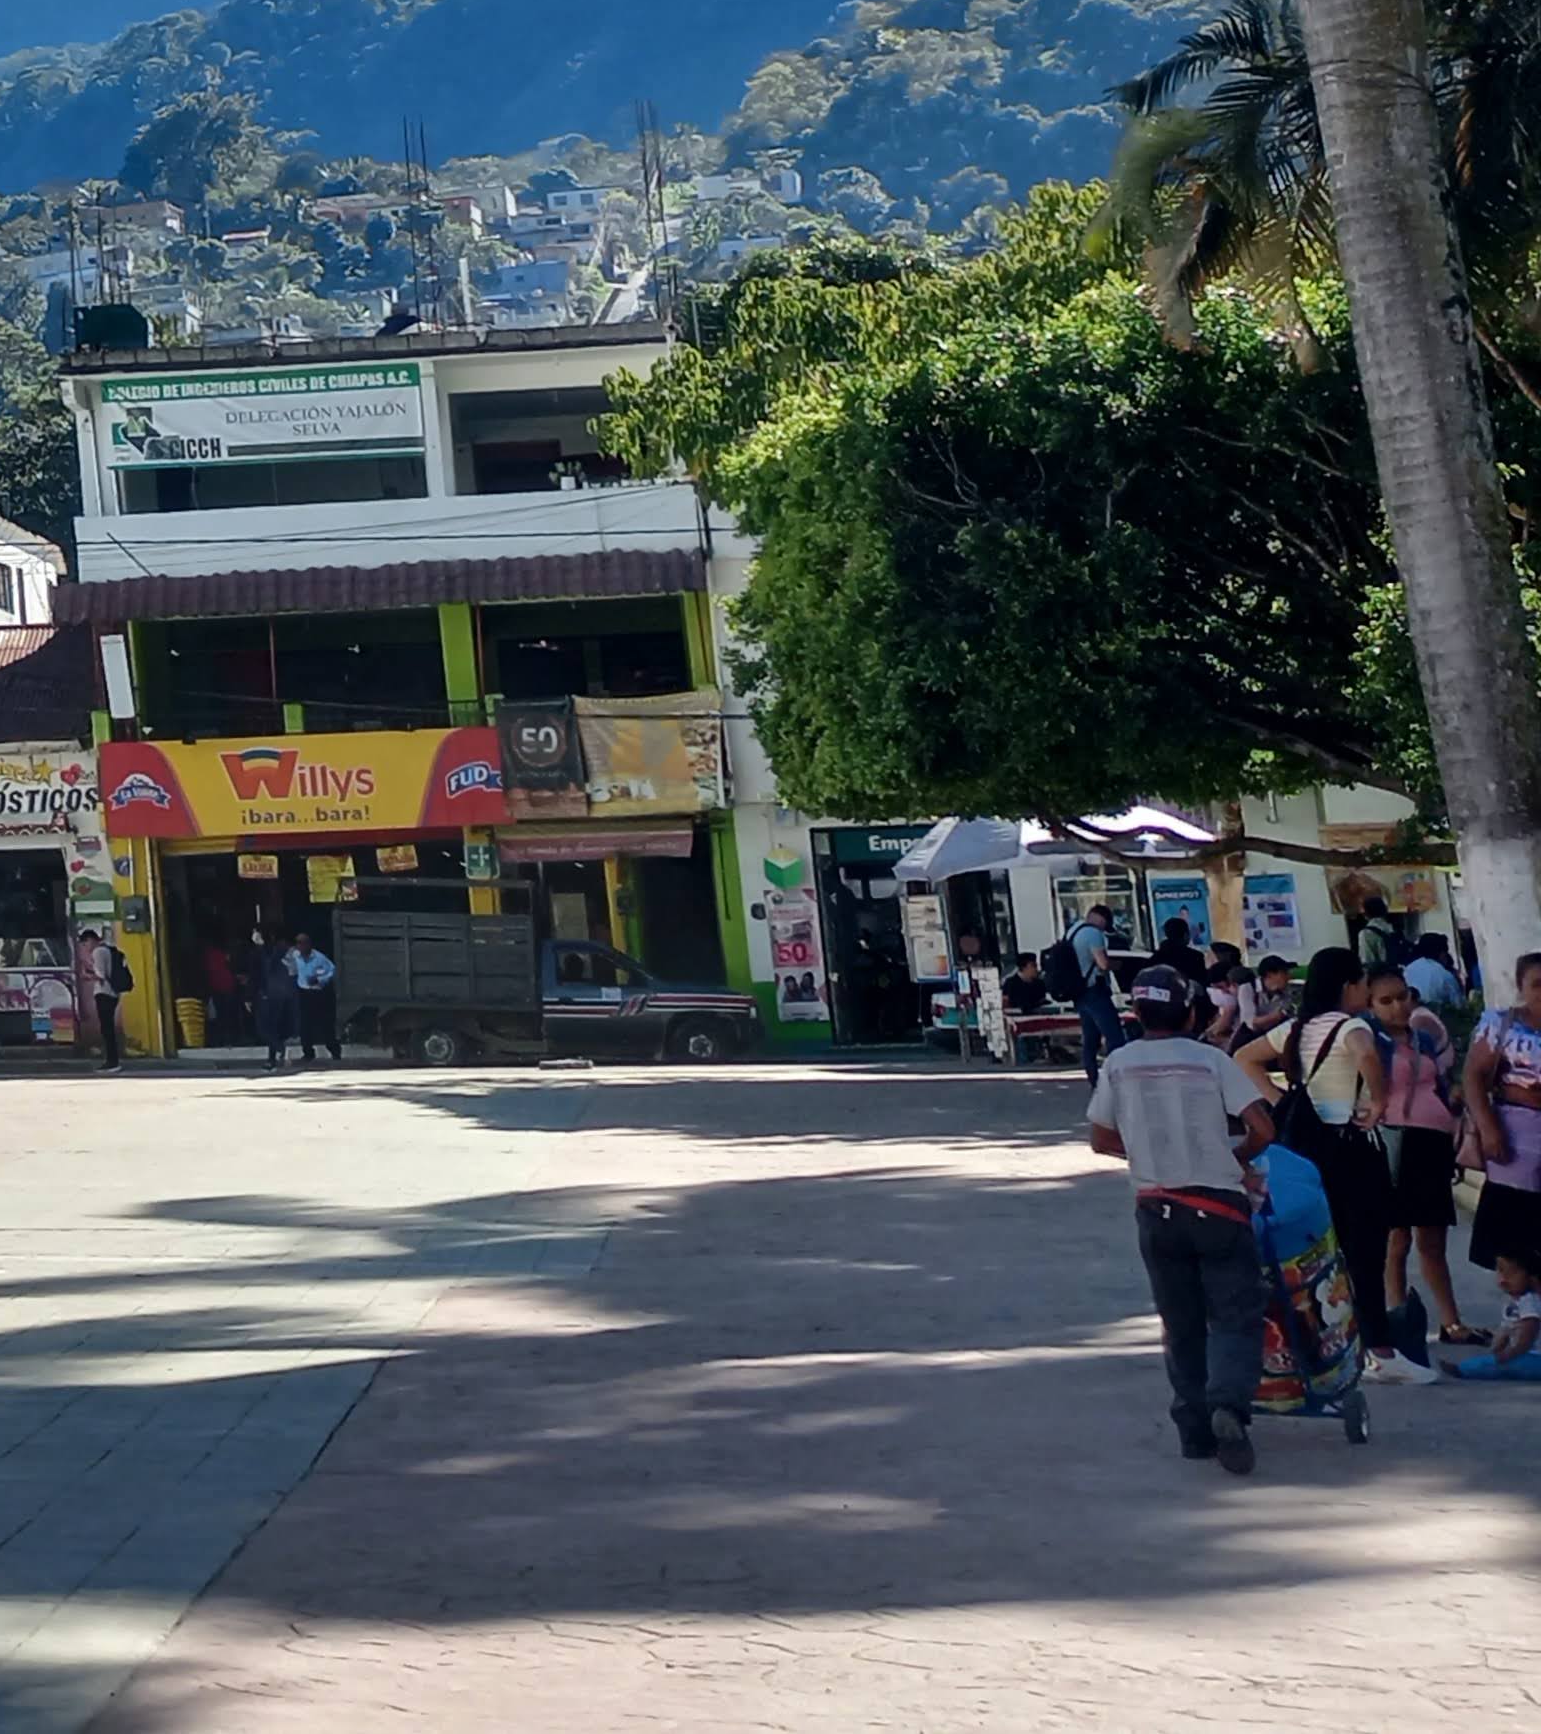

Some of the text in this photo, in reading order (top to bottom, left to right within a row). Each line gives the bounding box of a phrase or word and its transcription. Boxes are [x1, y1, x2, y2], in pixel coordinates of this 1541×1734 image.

[258, 377, 308, 393] CIVILES
[309, 376, 327, 390] DE
[387, 370, 412, 385] A.C.
[225, 402, 406, 424] DELEGACIÓN YAJALÓN
[292, 422, 342, 436] SELVA
[220, 746, 375, 803] Willys
[450, 766, 488, 792] FUD
[869, 834, 912, 856] Emp
